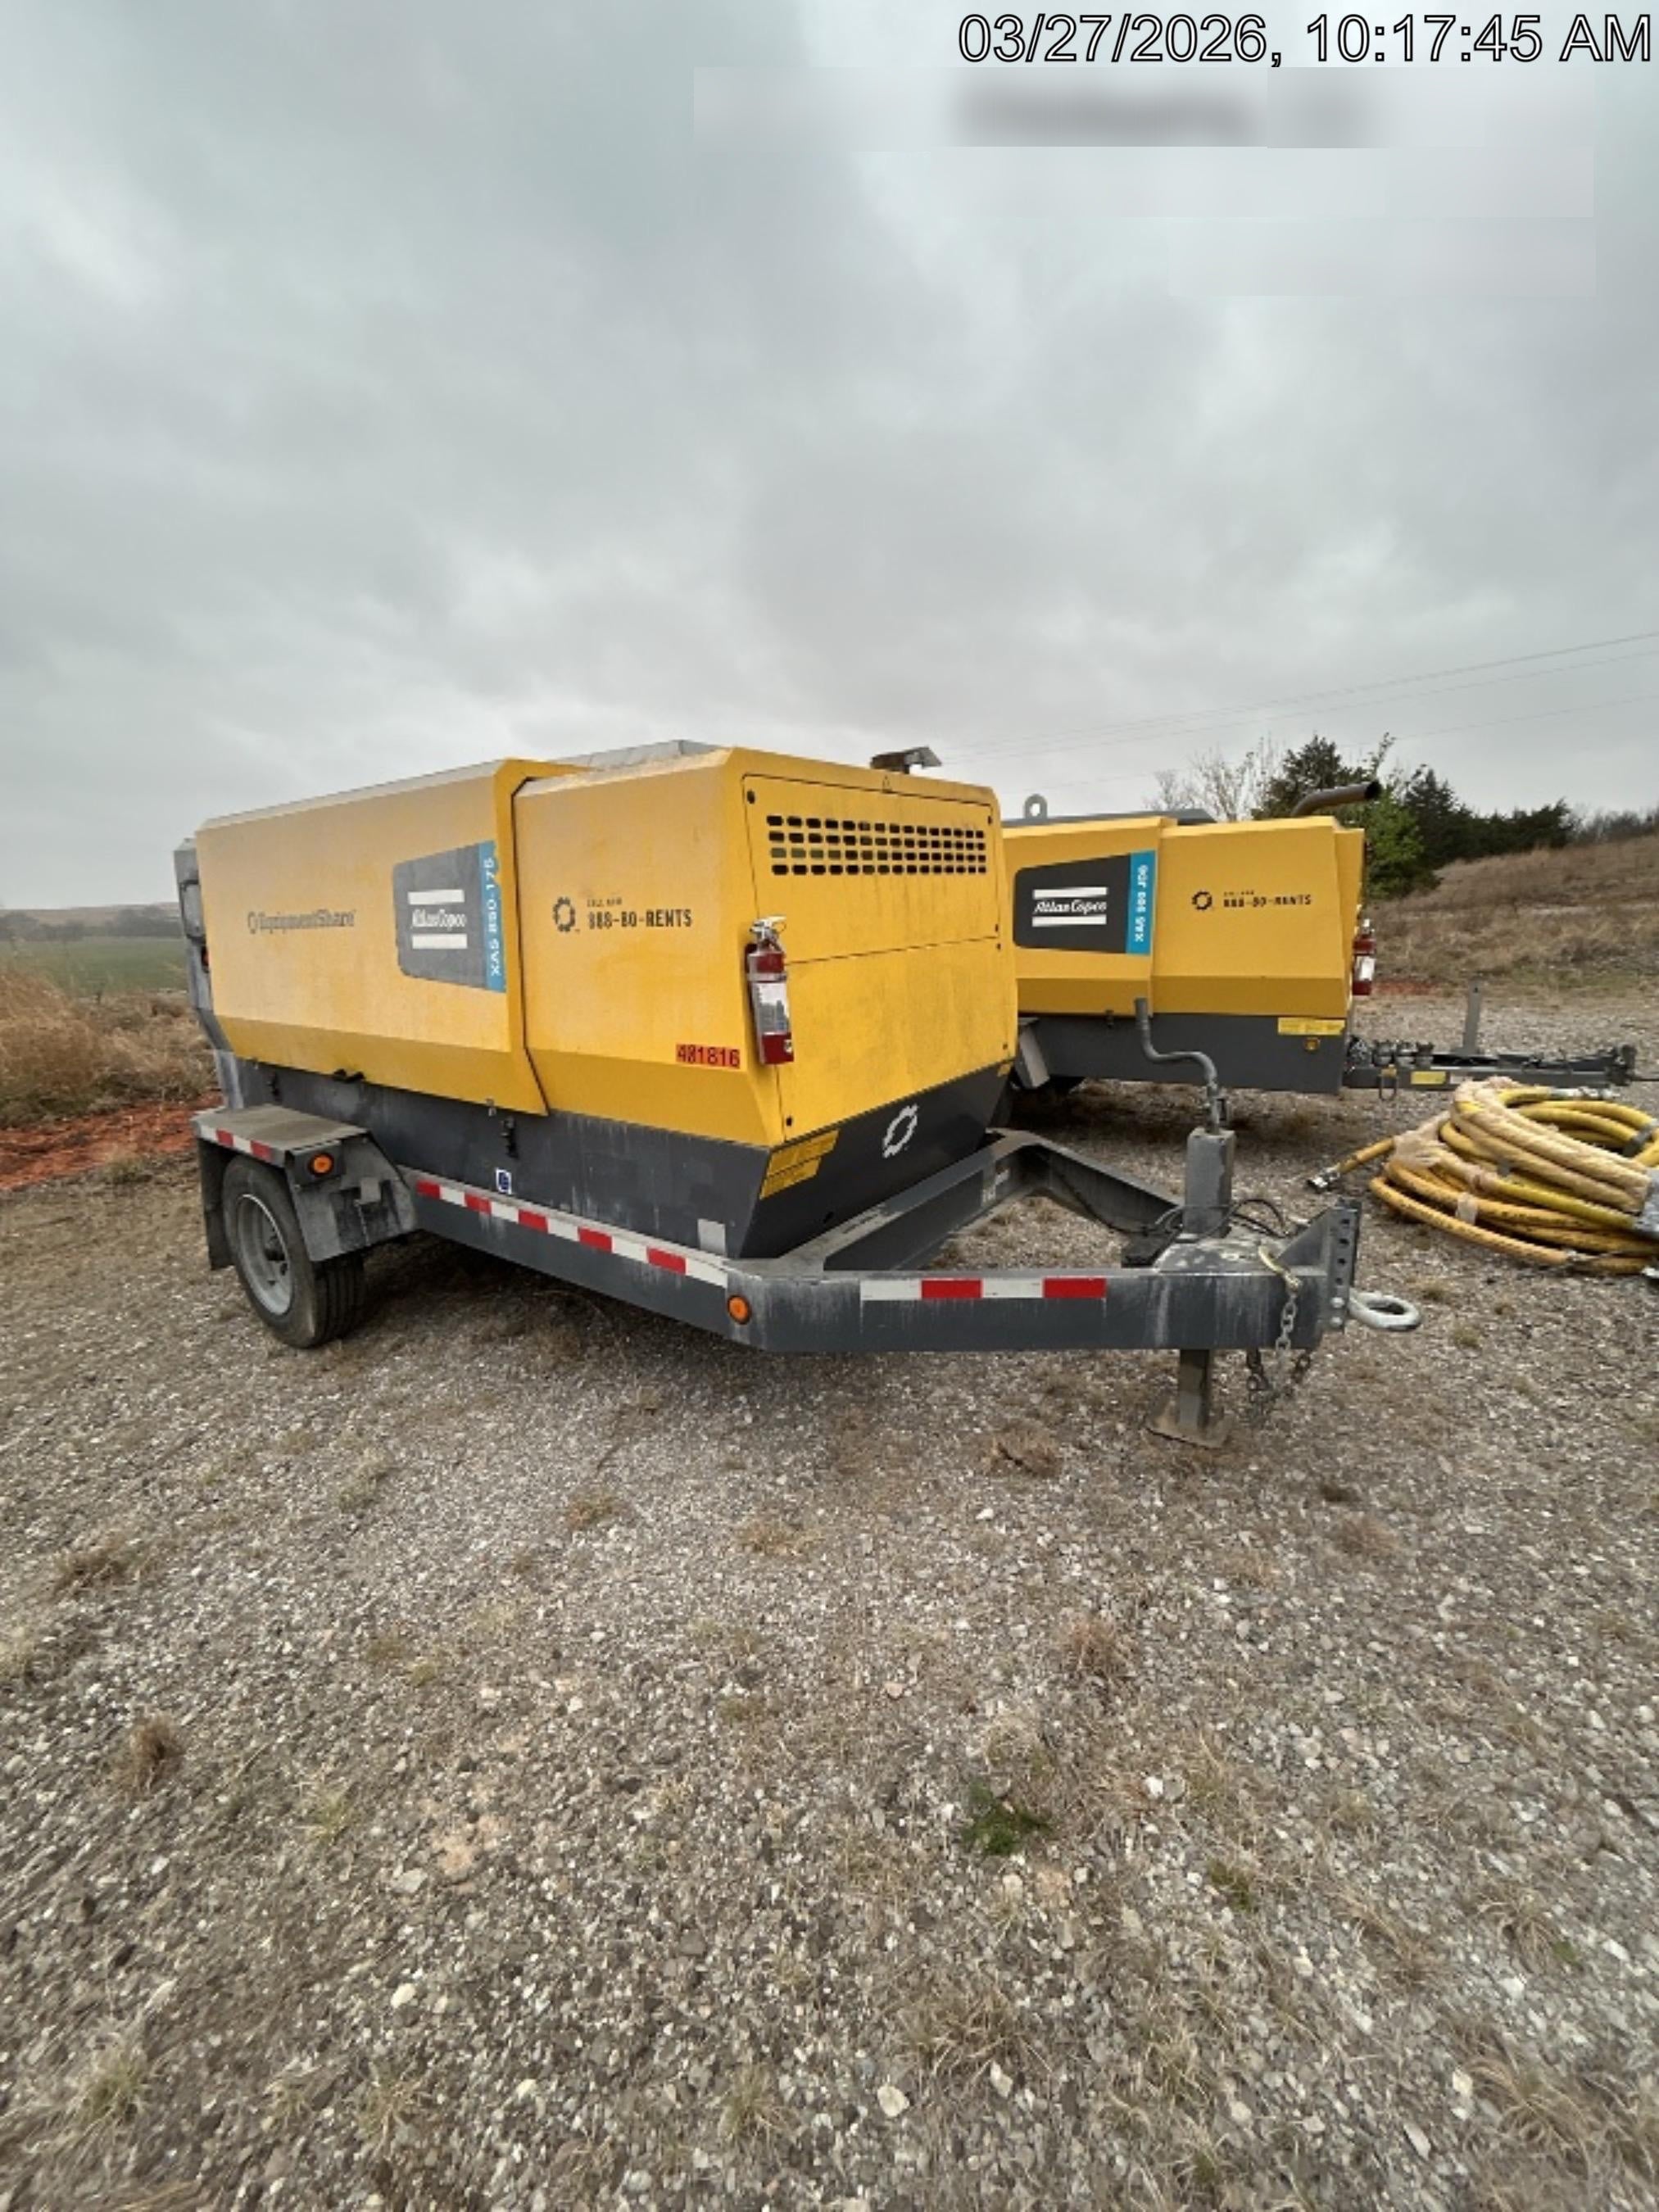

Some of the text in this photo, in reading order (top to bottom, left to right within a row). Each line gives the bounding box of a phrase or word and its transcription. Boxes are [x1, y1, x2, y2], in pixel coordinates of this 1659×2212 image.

[1032, 899, 1108, 915] Atlas Copco
[491, 938, 501, 977] XAS
